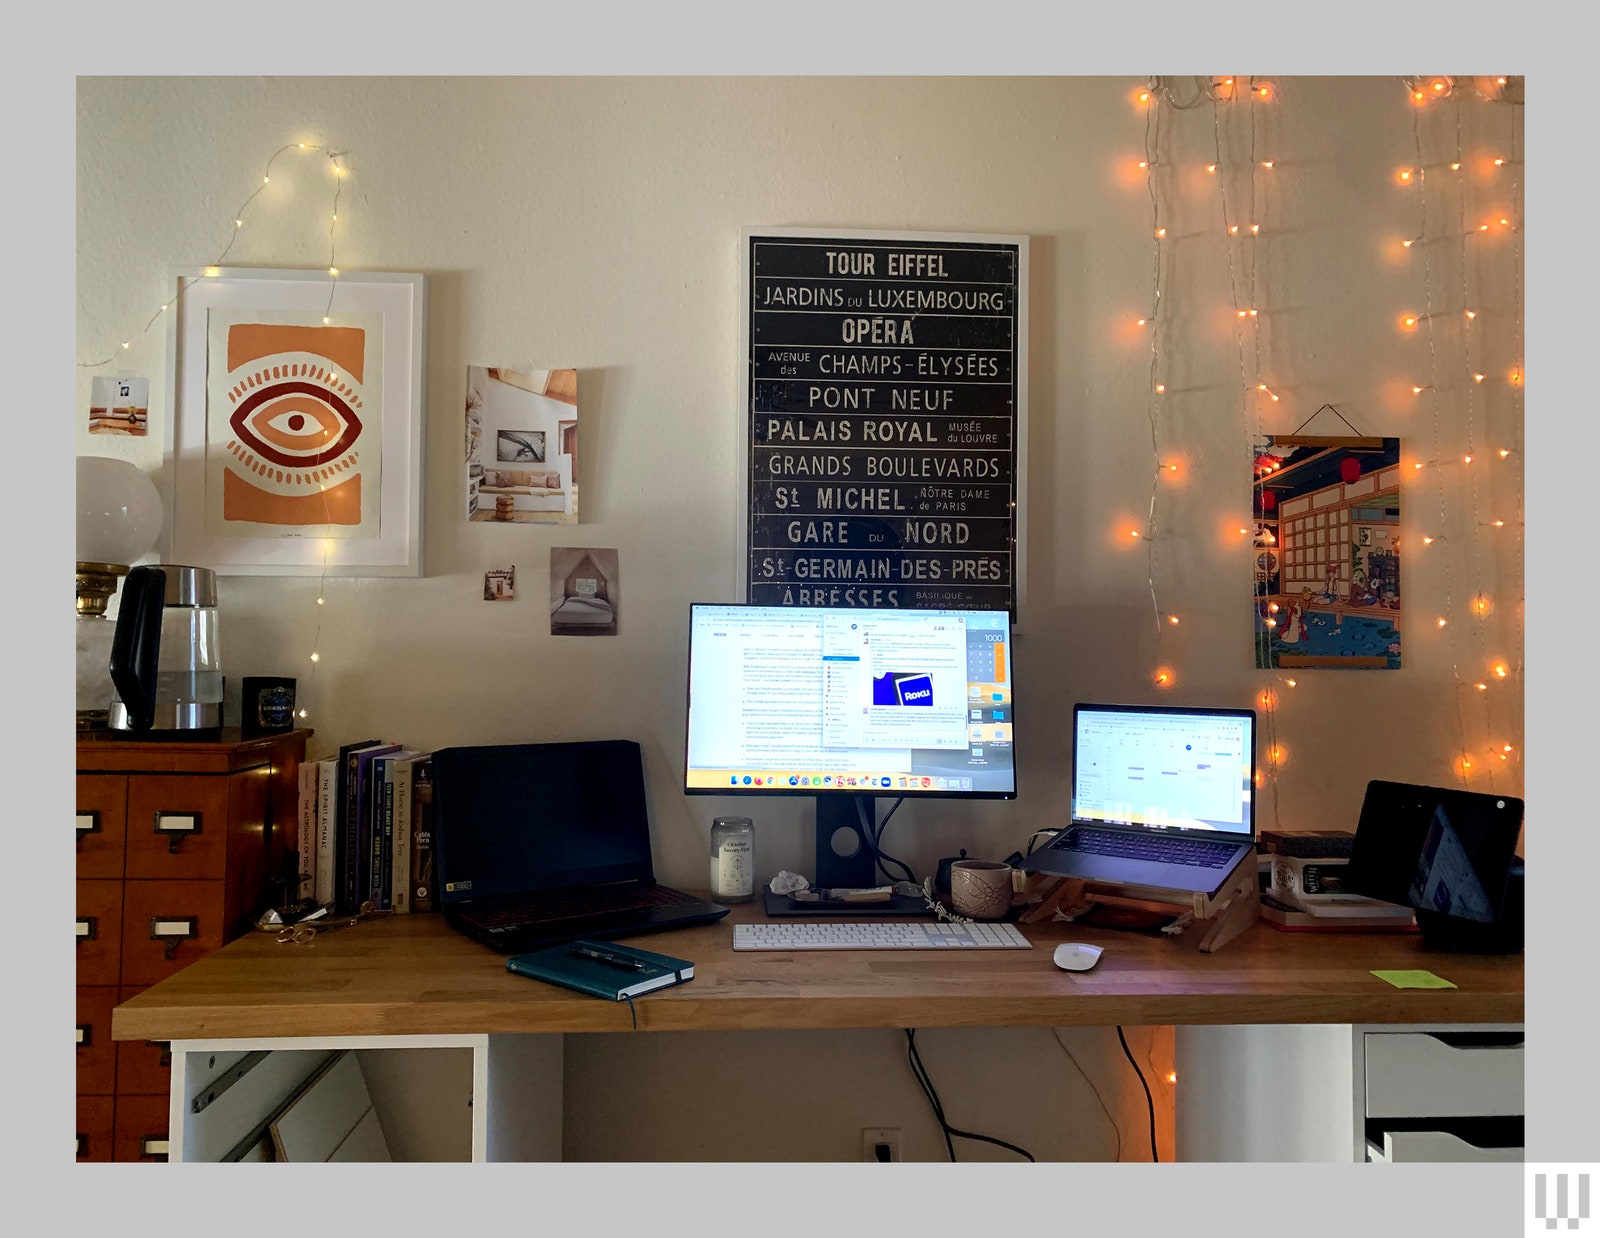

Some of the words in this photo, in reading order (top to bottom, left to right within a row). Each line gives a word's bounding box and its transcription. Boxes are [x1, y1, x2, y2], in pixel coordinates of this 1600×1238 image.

[826, 251, 875, 275] TOUR
[888, 254, 949, 278] EIFFEL
[763, 286, 844, 306] JARDINS
[868, 288, 1004, 311] LUXEMBOURG
[842, 316, 914, 345] OPÉRA
[768, 352, 811, 363] AVENUE
[780, 364, 797, 376] des
[809, 386, 876, 409] PONT
[892, 389, 954, 411] NEUF
[768, 419, 851, 442] PALAIS
[863, 421, 938, 443] ROYAL
[949, 420, 982, 432] MUSÉE
[947, 432, 958, 443] du
[960, 433, 998, 444] LOUVRE
[769, 455, 851, 476] GRANDS
[867, 457, 999, 478] BOULEVARDS
[775, 486, 800, 509] St
[817, 487, 906, 510] MICHEL
[960, 489, 990, 499] DAME
[919, 500, 930, 511] de
[936, 501, 967, 512] PARIS
[787, 521, 848, 543] GARE
[869, 533, 884, 543] DU
[906, 521, 970, 544] NORD
[984, 634, 1003, 642] 1000
[398, 790, 406, 809] Home
[320, 817, 328, 850] ALMANAC
[303, 846, 309, 854] OF
